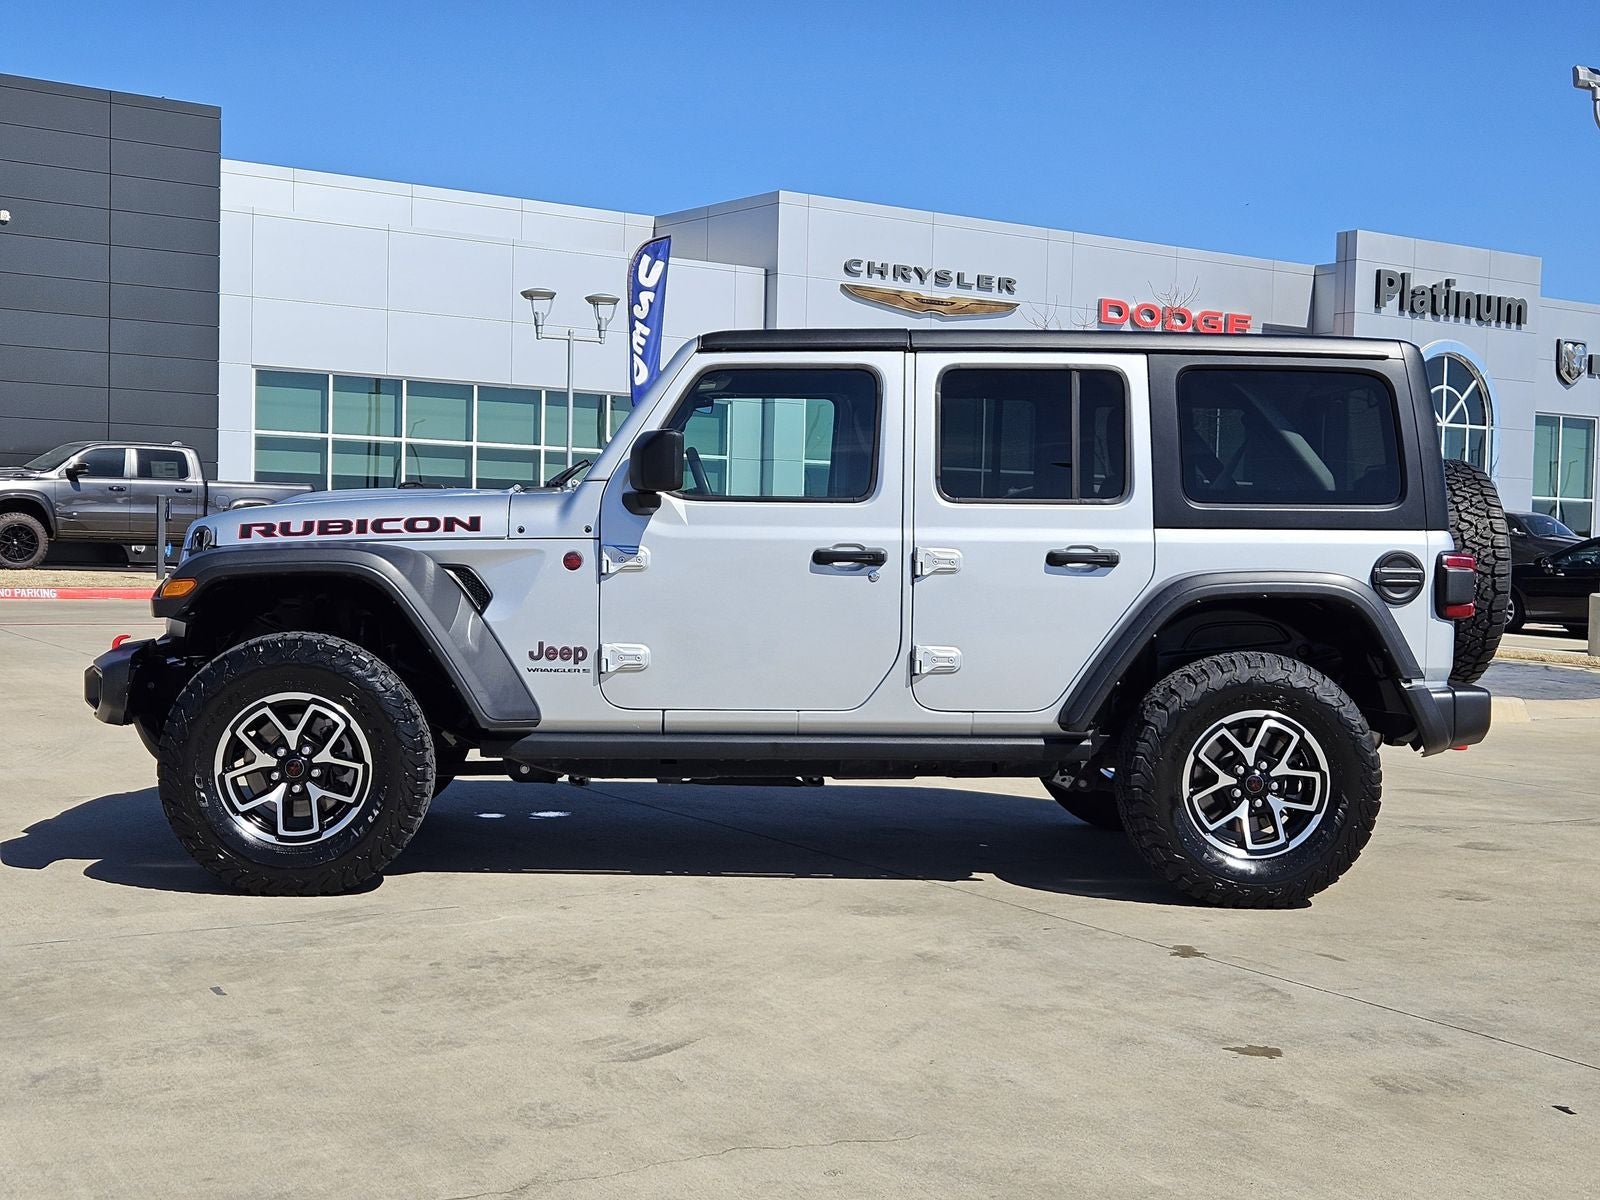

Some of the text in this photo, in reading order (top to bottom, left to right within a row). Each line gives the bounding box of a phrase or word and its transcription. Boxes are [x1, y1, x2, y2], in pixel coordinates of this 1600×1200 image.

[844, 258, 1017, 295] CHRYSLER
[1375, 268, 1528, 328] Platinum
[1098, 298, 1252, 334] DODGE
[238, 515, 482, 540] RUBICON
[14, 588, 57, 598] PARKING
[528, 640, 588, 665] Jeep
